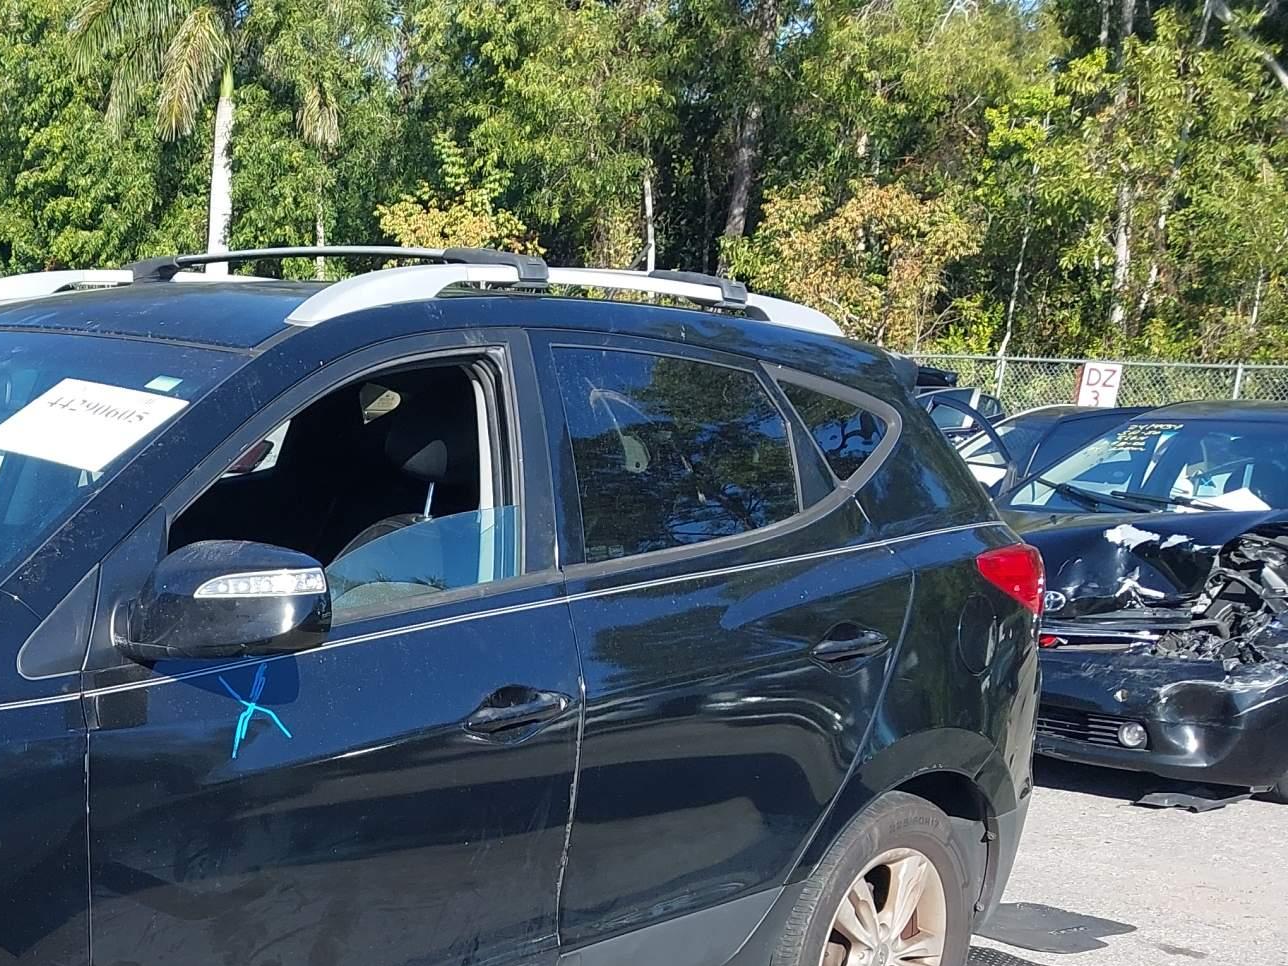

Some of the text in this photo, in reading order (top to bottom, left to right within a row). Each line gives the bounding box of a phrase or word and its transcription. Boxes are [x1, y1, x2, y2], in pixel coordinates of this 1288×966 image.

[1086, 368, 1117, 387] DZ
[1088, 390, 1100, 407] 3
[47, 396, 151, 424] 44290605
